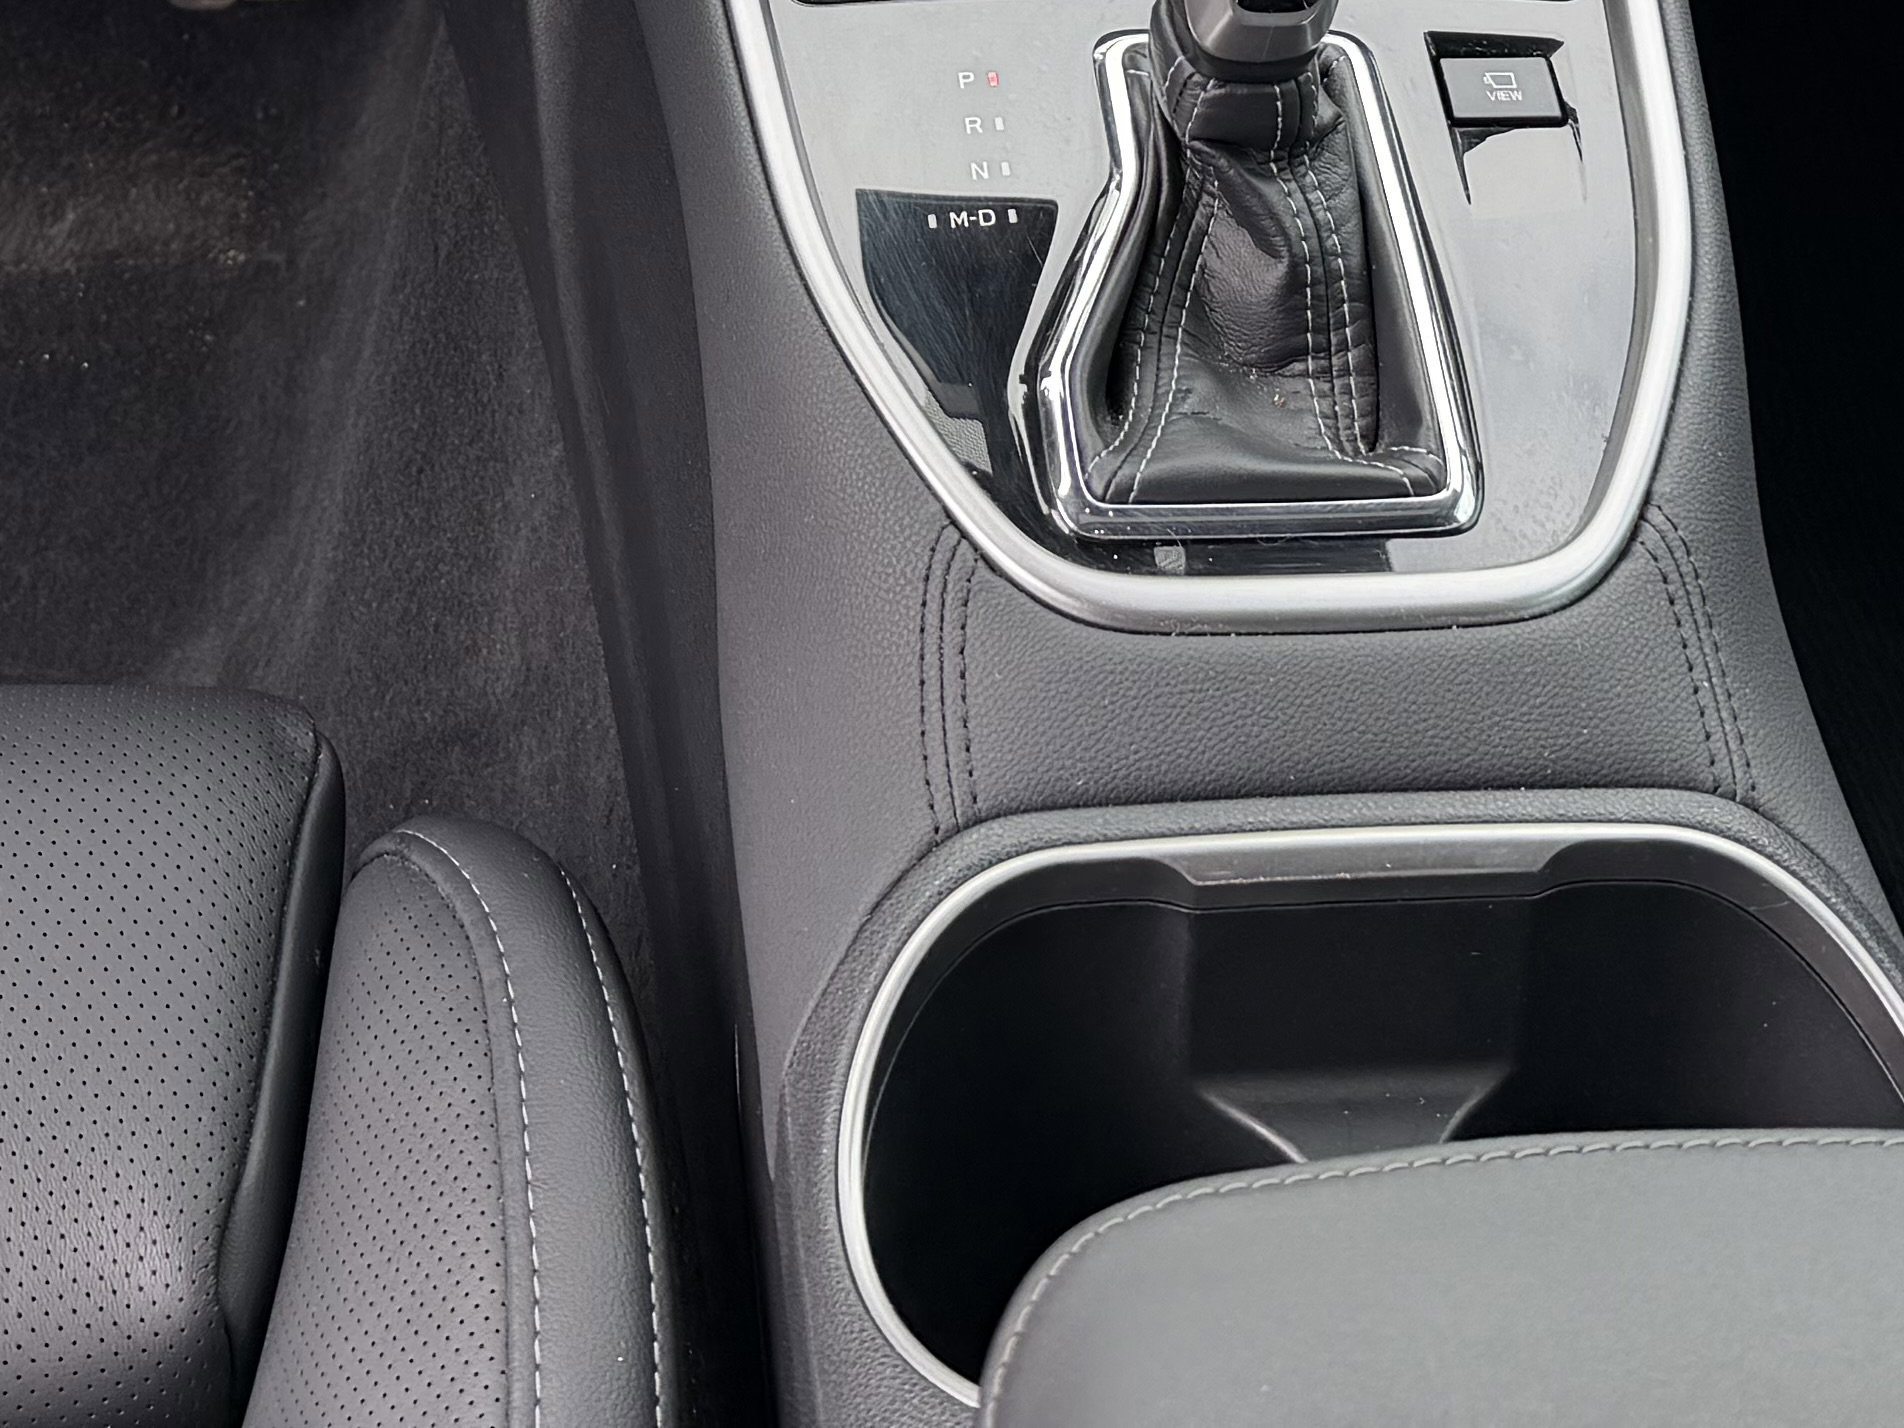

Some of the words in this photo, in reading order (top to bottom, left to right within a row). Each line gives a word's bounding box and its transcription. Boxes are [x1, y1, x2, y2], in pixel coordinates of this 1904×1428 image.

[958, 71, 975, 88] P
[1486, 90, 1523, 101] VIEW
[964, 116, 983, 134] R
[970, 161, 989, 180] N
[949, 208, 996, 228] M-D
